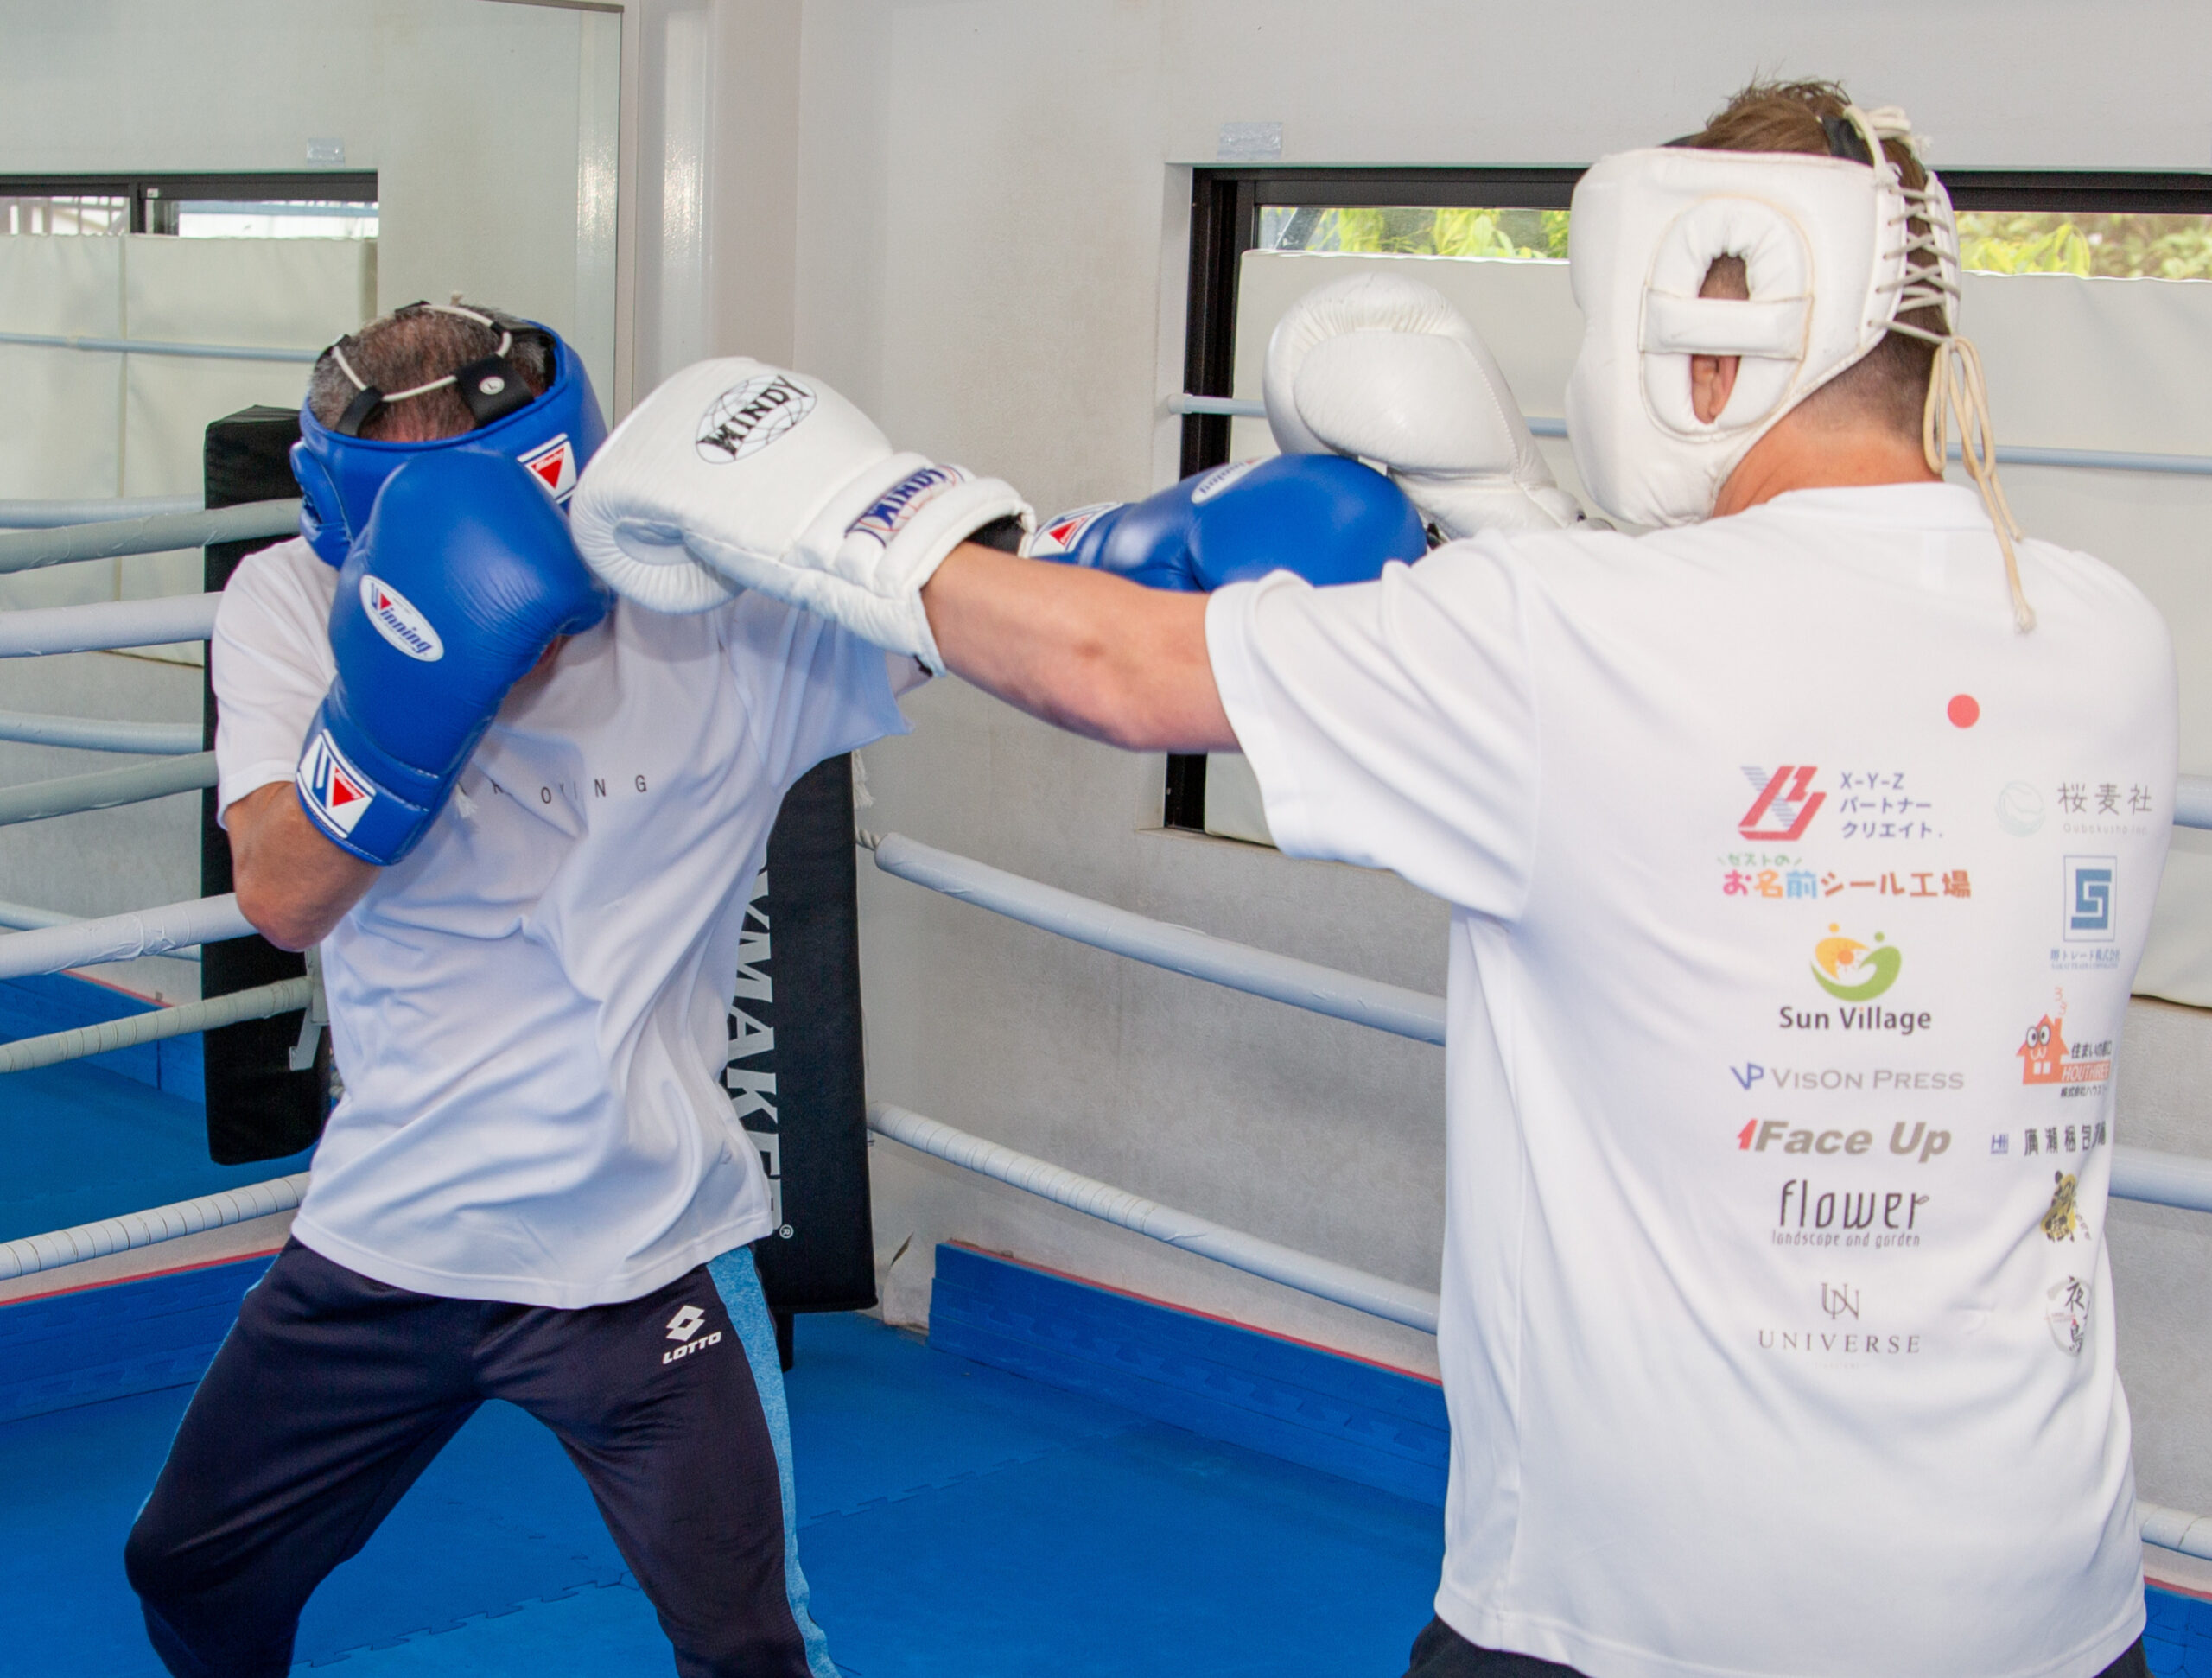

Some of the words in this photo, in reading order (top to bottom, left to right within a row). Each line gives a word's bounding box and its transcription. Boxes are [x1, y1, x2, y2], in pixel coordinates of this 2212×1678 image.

[1840, 772, 1905, 790] X-Y-Z
[1840, 798, 1932, 814] パートナー
[2057, 782, 2153, 816] 桜麦社
[1722, 869, 1972, 899] お名前シール工場
[1779, 1006, 1830, 1029] Sun
[1839, 1006, 1932, 1035] Village
[1889, 1121, 1952, 1164] Up
[1780, 1179, 1930, 1230] flower
[1846, 1232, 1871, 1248] and
[1875, 1230, 1921, 1249] garden
[662, 1331, 722, 1365] LOTTO
[1758, 1330, 1921, 1354] UNIVERSE
